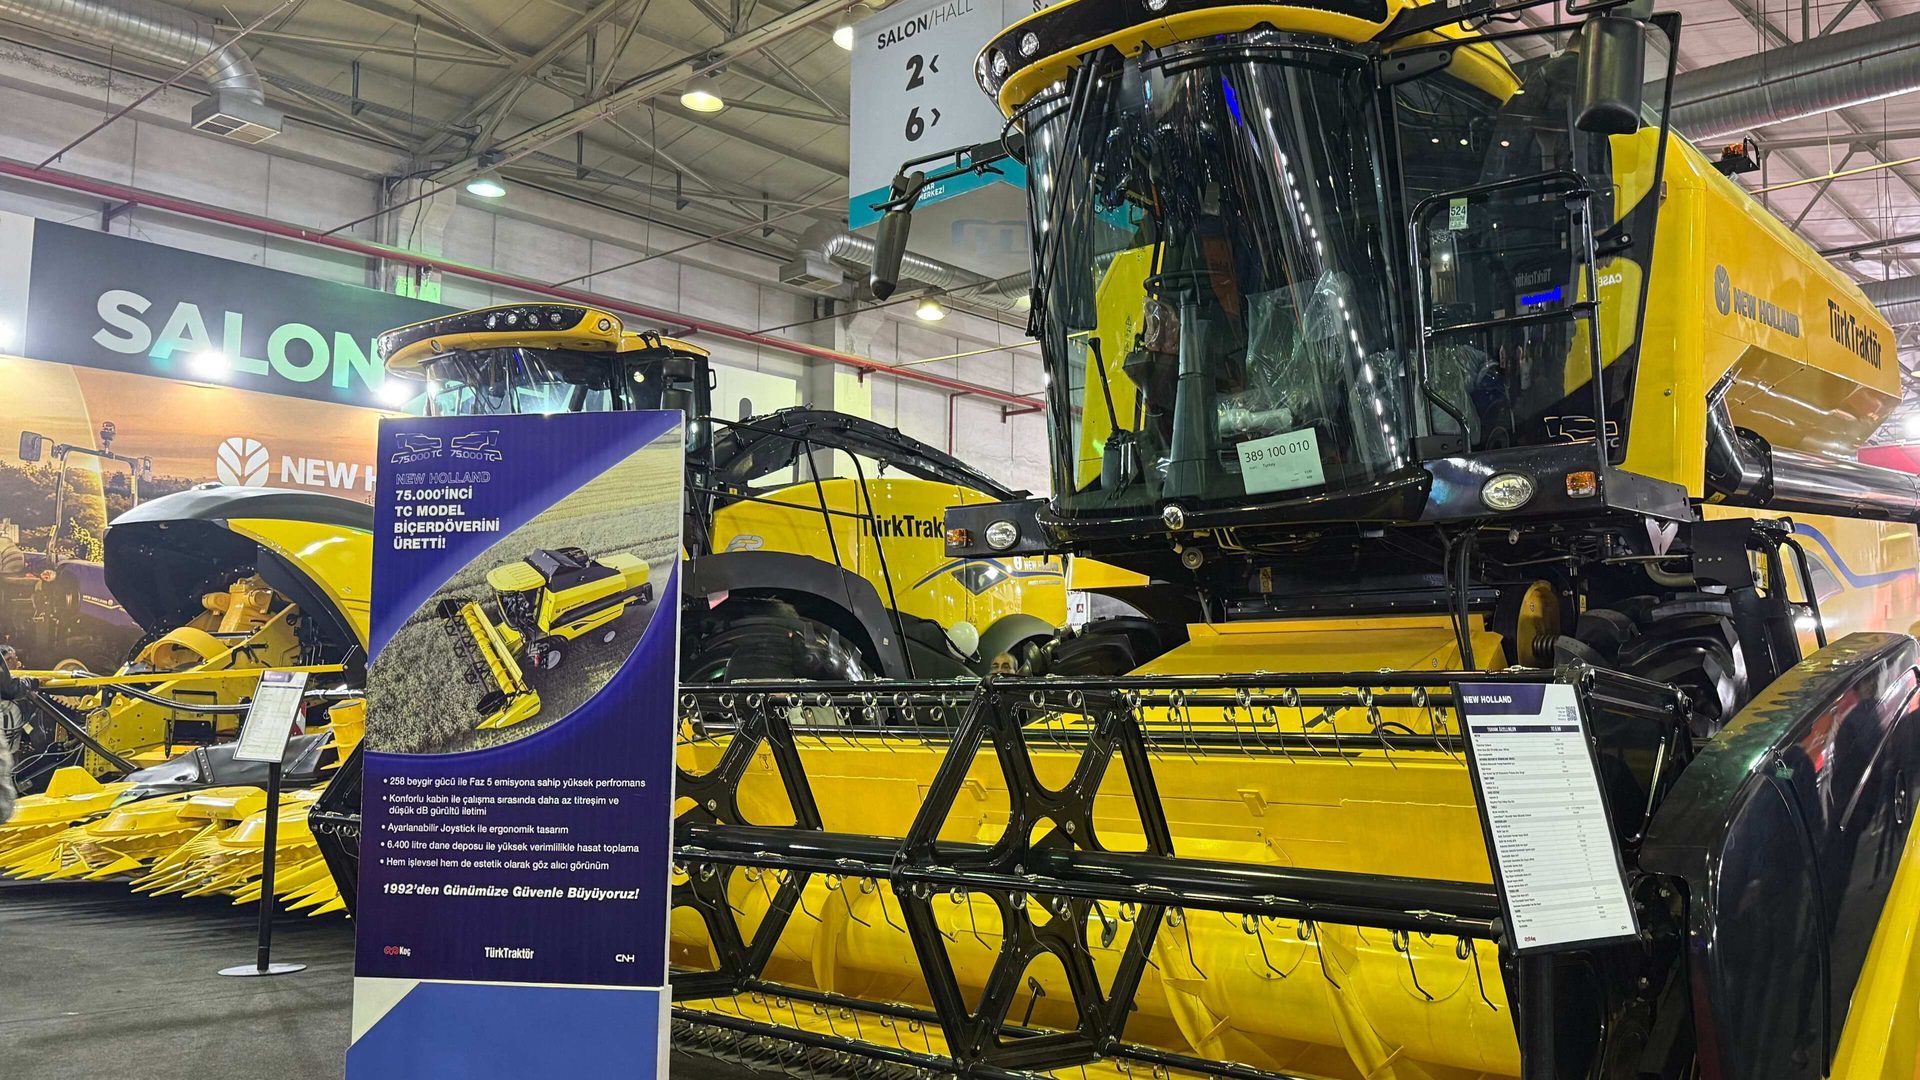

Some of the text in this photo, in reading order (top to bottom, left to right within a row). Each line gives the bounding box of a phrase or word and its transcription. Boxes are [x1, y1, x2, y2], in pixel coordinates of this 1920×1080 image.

[877, 0, 974, 50] SALON/HALL
[905, 54, 924, 92] 2
[905, 106, 924, 142] 6
[1450, 206, 1466, 216] 524
[1734, 288, 1800, 338] NEW HOLLAND
[92, 289, 386, 393] SALON
[1827, 298, 1882, 370] TürkTraktör
[431, 449, 443, 458] TC
[484, 453, 496, 462] TC
[1244, 440, 1310, 463] 389 100 010
[281, 455, 358, 490] NEW
[395, 471, 491, 485] NEW HOLLAND
[396, 485, 473, 501] 75.000'İNCİ
[394, 504, 465, 518] TC MODEL
[394, 518, 500, 536] BİÇERDÖVERİNİ
[393, 534, 446, 550] ÜRETTİ!
[1463, 696, 1512, 704] NEW HOLLAND
[390, 776, 646, 788] 258 beygir gücü ile Faz 5 emisyona sahip yüksek perfromans
[389, 794, 424, 803] Konforlu
[426, 794, 449, 804] kabin
[451, 795, 461, 804] ile
[462, 795, 496, 805] çalışma
[497, 796, 536, 804] sırasında
[538, 796, 560, 804] daha
[574, 796, 606, 806] titreşim
[389, 806, 487, 816] düşük dB gürültü iletimi
[387, 822, 569, 835] Ayarlanabilir Joystick ile ergonomik tasarım
[386, 840, 640, 854] 6.400 litre dane deposu ile yüksek verimlilikle hasat toplama
[386, 857, 610, 872] Hem işlevsel hem de estetik olarak göz alıcı görünüm
[383, 883, 640, 901] 1992'den Günümüze Güvenle Büyüyoruz!
[399, 946, 412, 957] Koç
[484, 947, 534, 960] TürkTraktör
[615, 954, 635, 962] CNH
